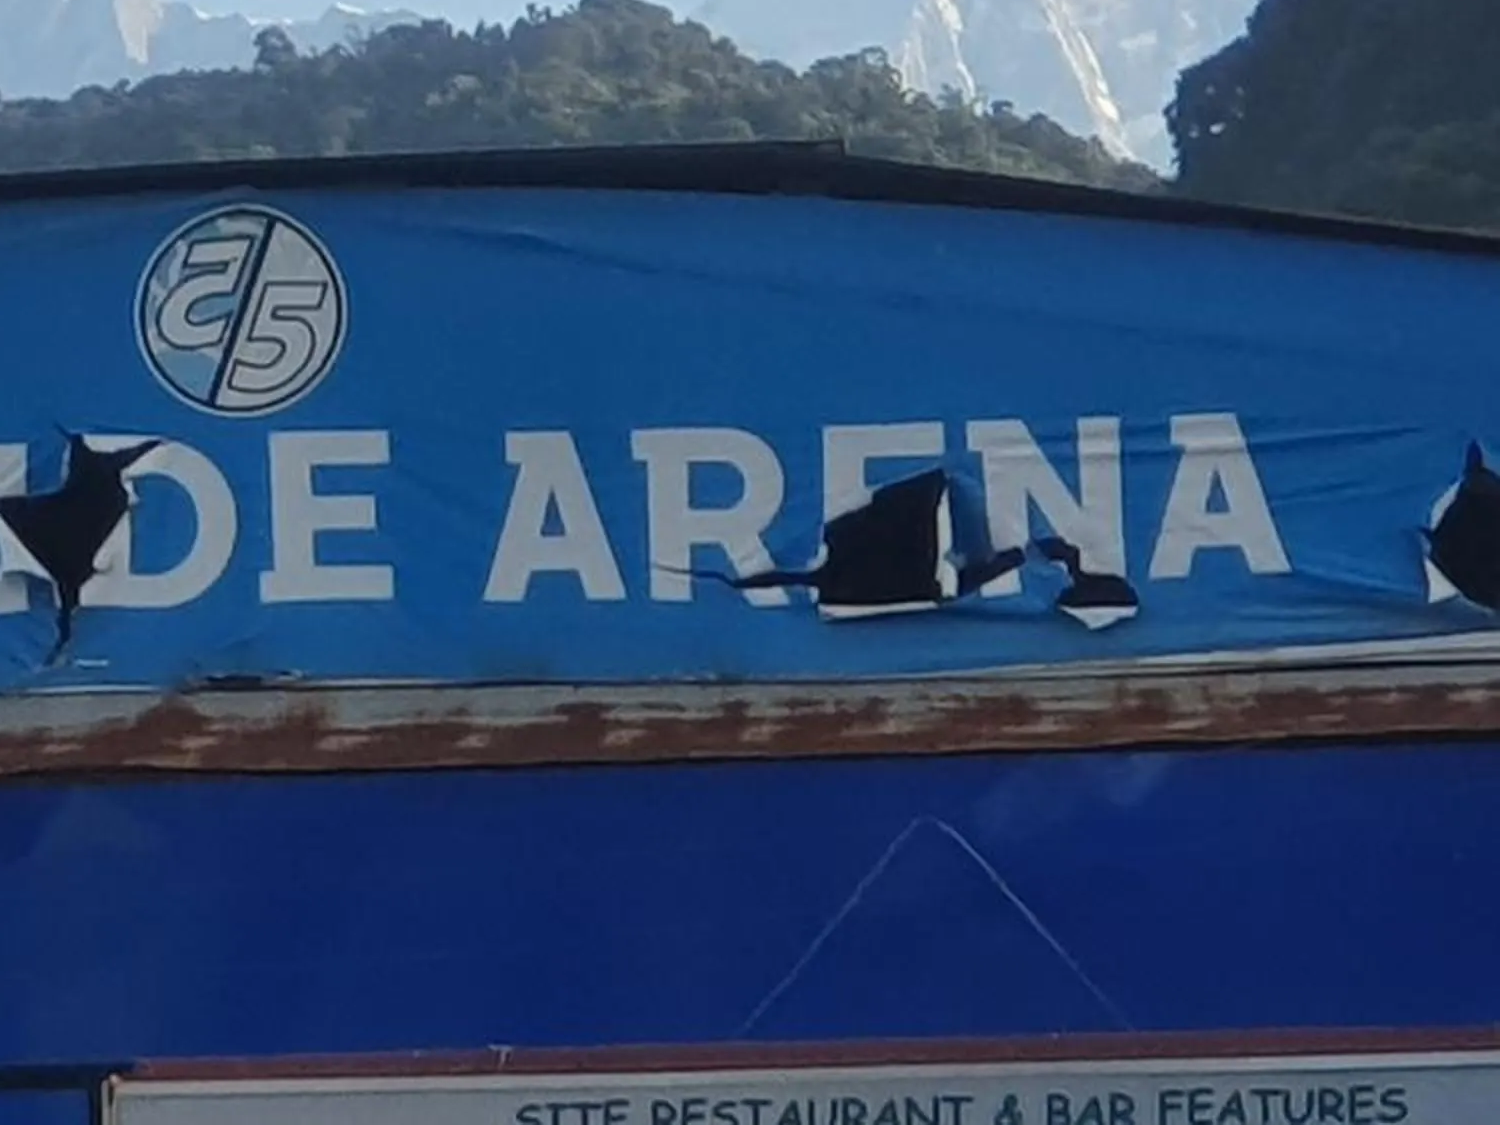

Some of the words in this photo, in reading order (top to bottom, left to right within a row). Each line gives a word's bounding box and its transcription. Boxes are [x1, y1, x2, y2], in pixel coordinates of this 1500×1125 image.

[649, 1095, 975, 1125] RESTAURANT
[992, 1093, 1023, 1125] &
[1044, 1091, 1137, 1125] BAR
[1156, 1085, 1410, 1125] FEATURES
